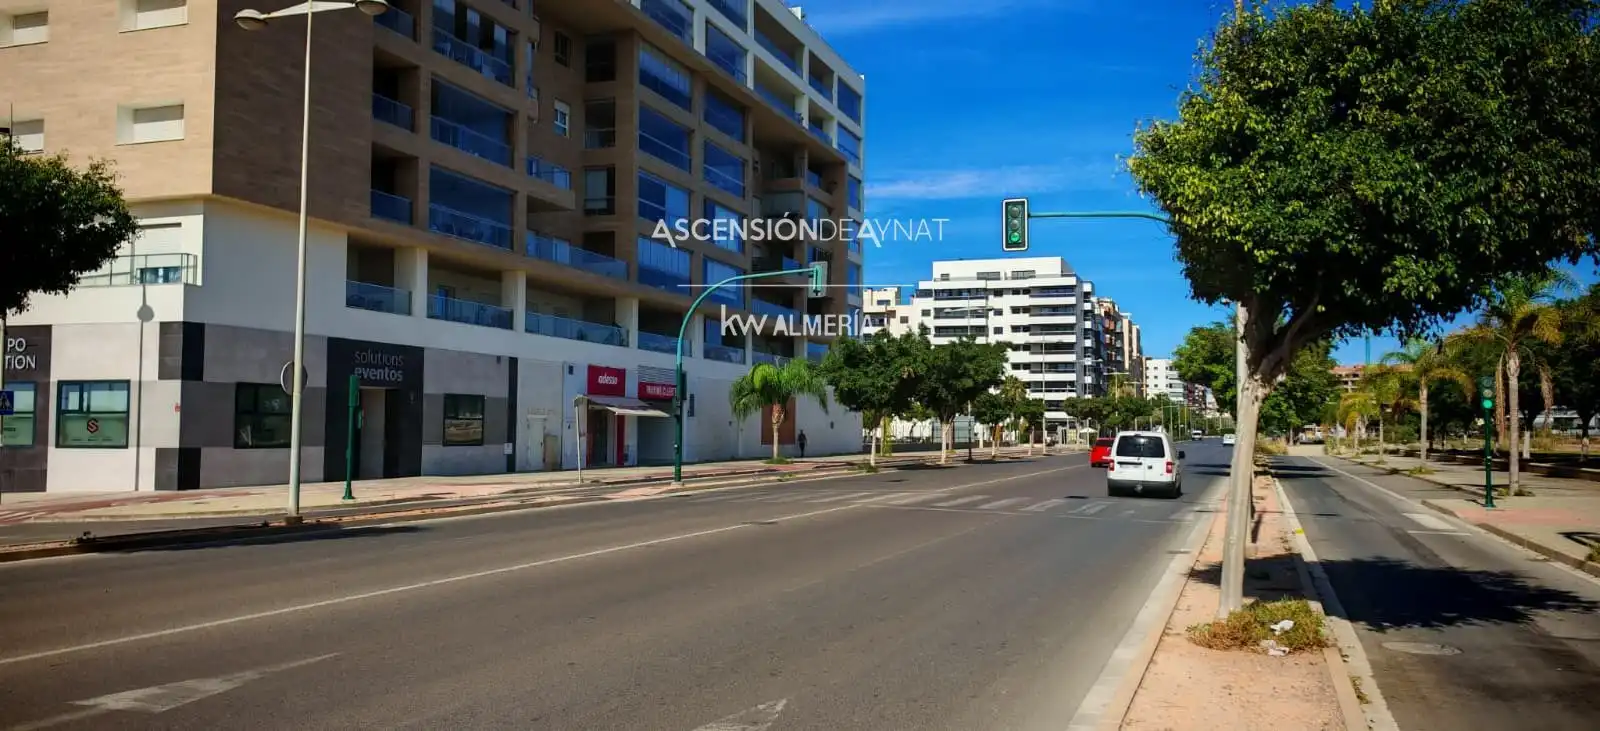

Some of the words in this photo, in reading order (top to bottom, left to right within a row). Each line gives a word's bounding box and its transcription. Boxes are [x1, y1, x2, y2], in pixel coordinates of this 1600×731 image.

[354, 348, 404, 366] solutions
[354, 366, 403, 382] eventos
[598, 373, 618, 385] adesso
